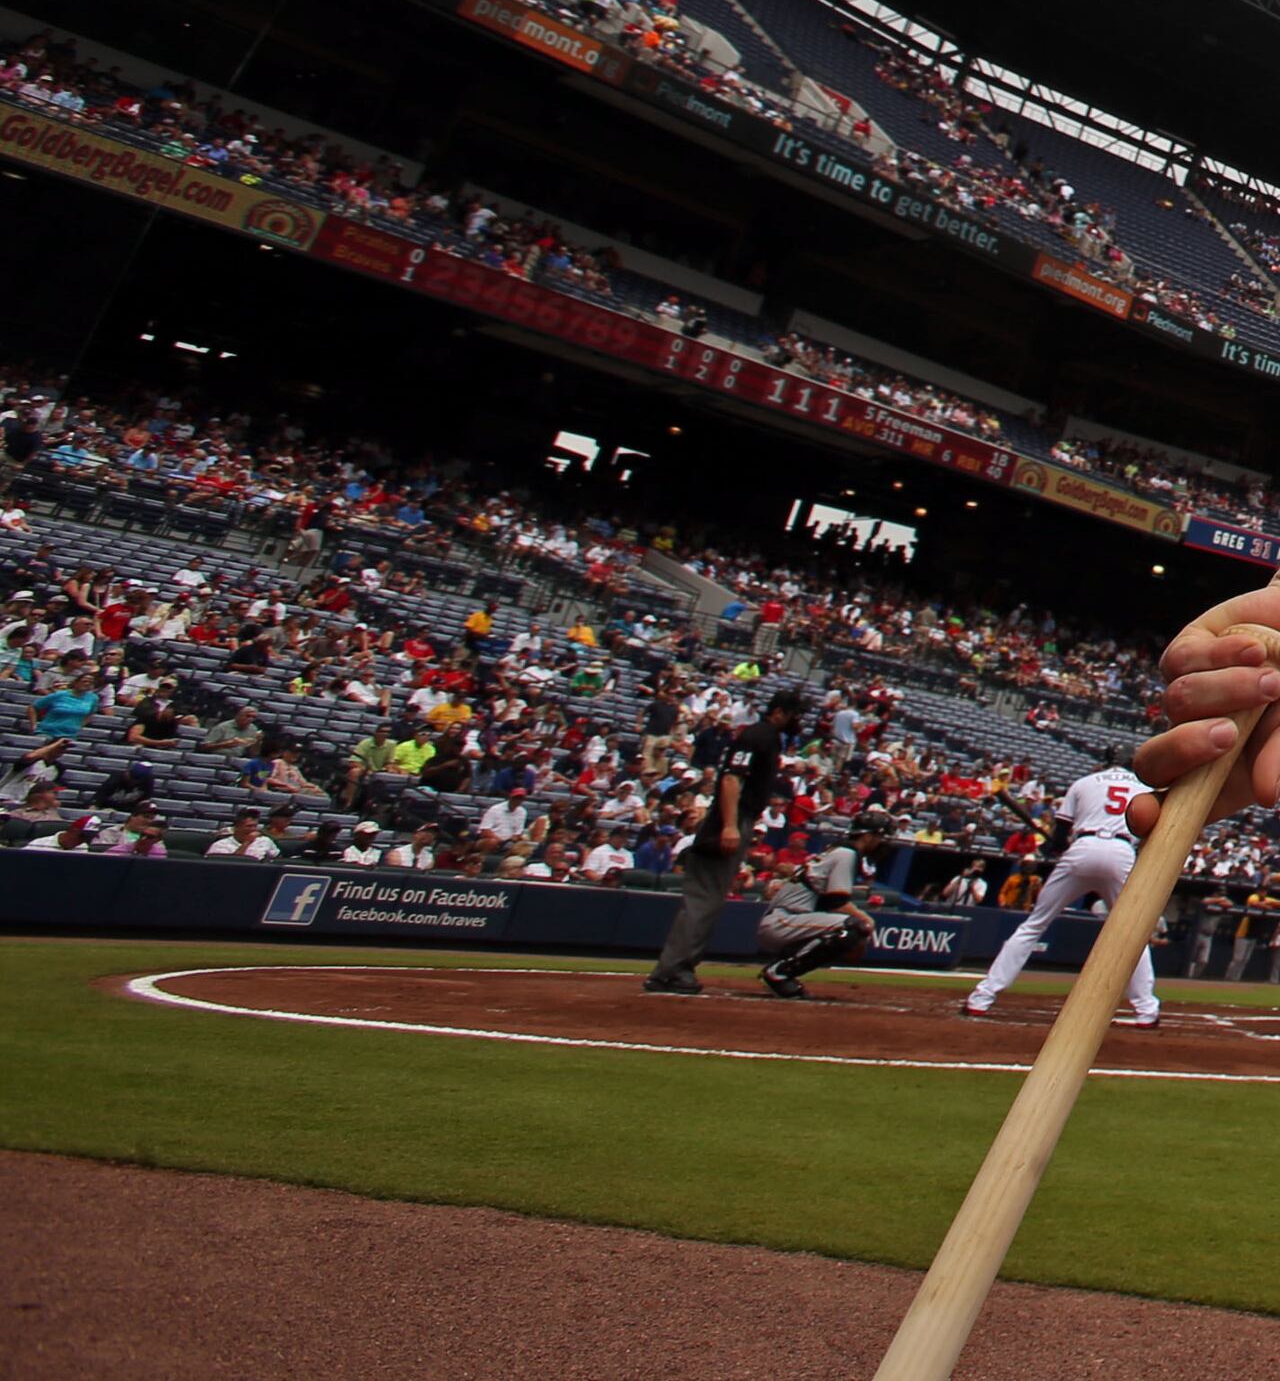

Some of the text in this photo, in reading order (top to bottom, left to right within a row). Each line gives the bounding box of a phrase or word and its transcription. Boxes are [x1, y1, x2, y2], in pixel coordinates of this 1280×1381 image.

[655, 80, 733, 129] Piedmont
[1, 112, 235, 213] GoldbergBagel.com
[773, 132, 1000, 255] It's time to get better.
[409, 247, 425, 264] 0
[400, 266, 415, 282] 1
[1039, 262, 1128, 315] piedmont.org
[1146, 311, 1194, 343] Piedmont
[671, 338, 742, 374] 0 0 0
[1222, 341, 1249, 365] It's
[696, 365, 708, 380] 2
[723, 374, 735, 390] 0
[842, 415, 877, 438] AVG
[876, 429, 905, 447] .311
[864, 405, 944, 445] 5 Freeman
[1211, 530, 1245, 551] GREG
[1250, 537, 1272, 560] 31
[731, 750, 753, 767] 91
[1104, 785, 1130, 816] 5
[331, 881, 378, 901] Find
[377, 885, 400, 902] us
[402, 888, 428, 904] on
[336, 905, 488, 928] facebook.com/braves
